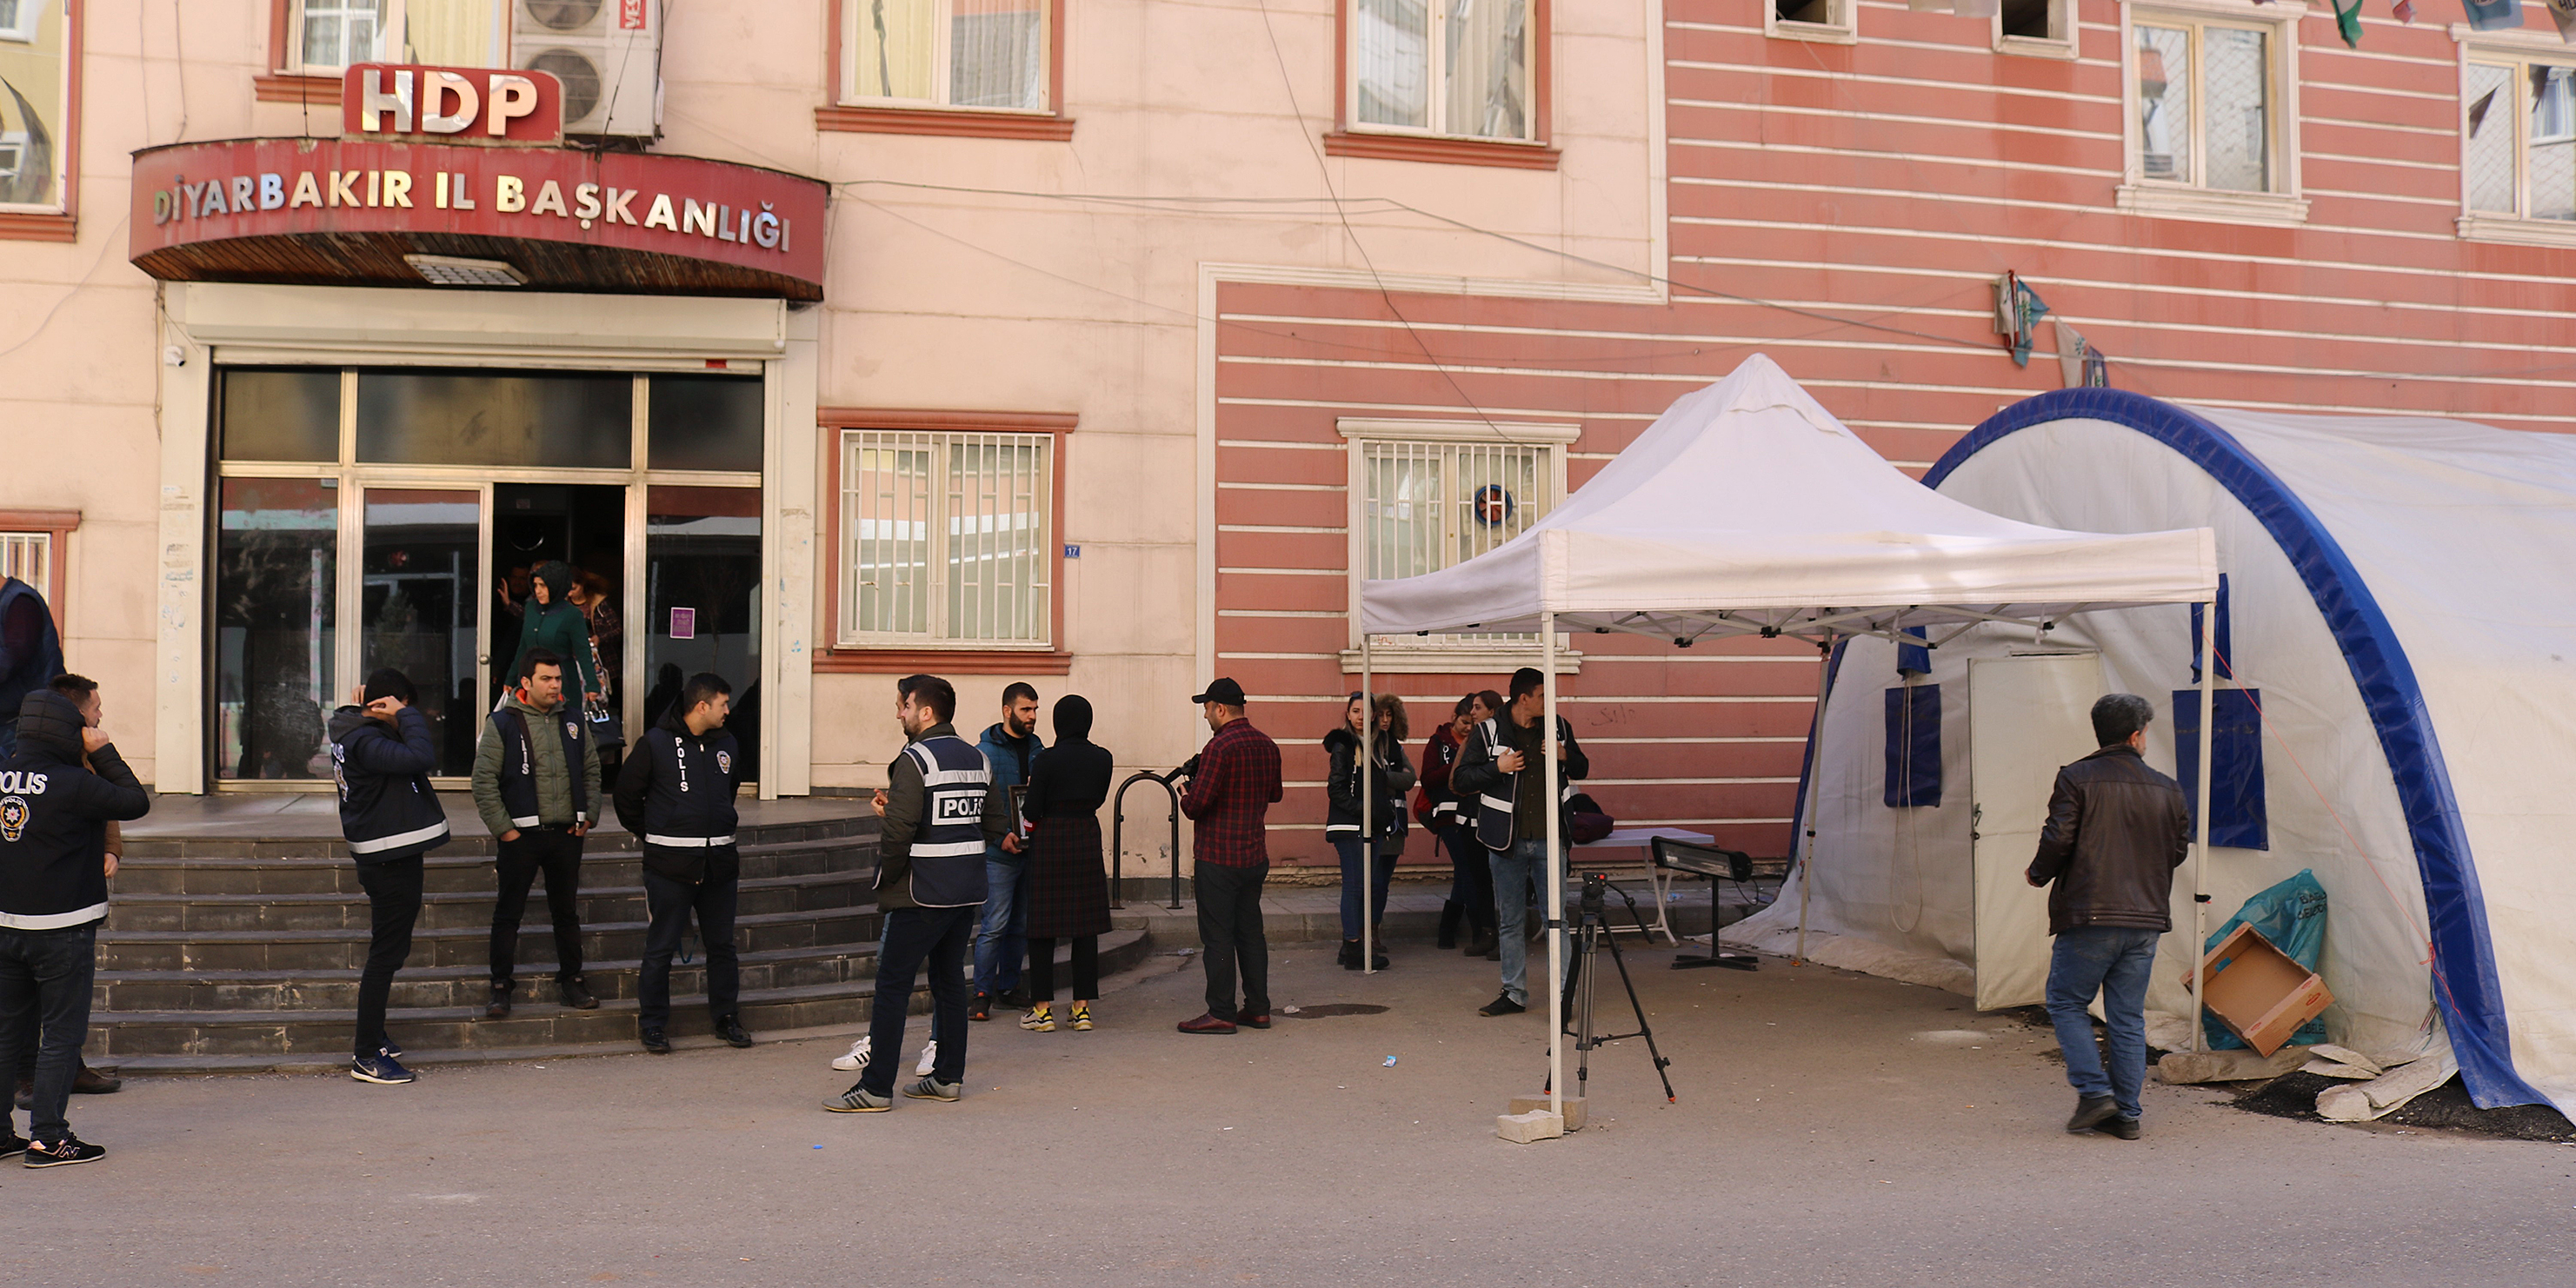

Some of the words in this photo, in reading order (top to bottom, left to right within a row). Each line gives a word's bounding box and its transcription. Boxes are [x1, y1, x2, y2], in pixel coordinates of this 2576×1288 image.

[362, 70, 538, 136] HDP
[154, 170, 414, 225] DİYARBAKIR
[496, 175, 790, 252] BAŞKANLIĞI
[0, 770, 48, 794] OLIS
